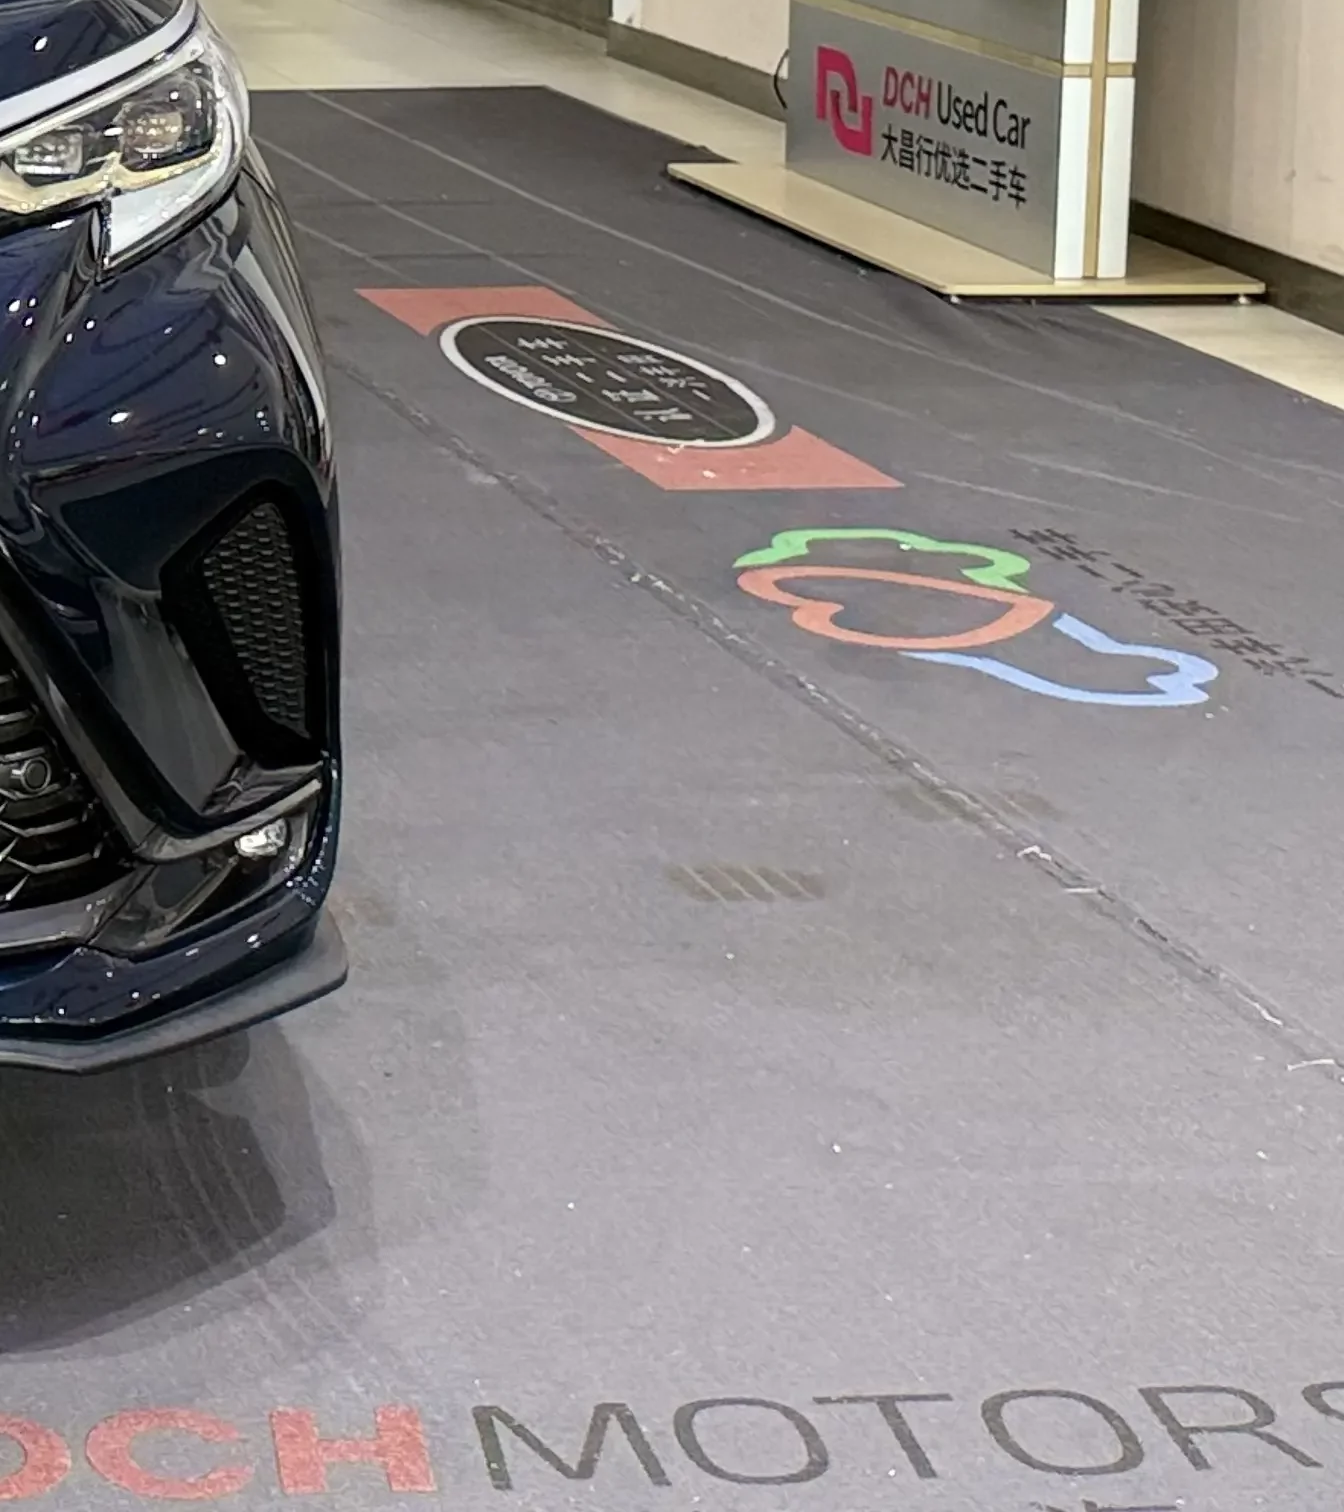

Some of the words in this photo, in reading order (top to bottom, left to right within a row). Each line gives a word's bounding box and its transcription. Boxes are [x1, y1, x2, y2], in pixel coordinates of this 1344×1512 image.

[882, 65, 933, 121] DCH
[936, 80, 989, 139] Used
[992, 97, 1031, 151] Car
[880, 122, 1027, 210] 大昌行优选二手车
